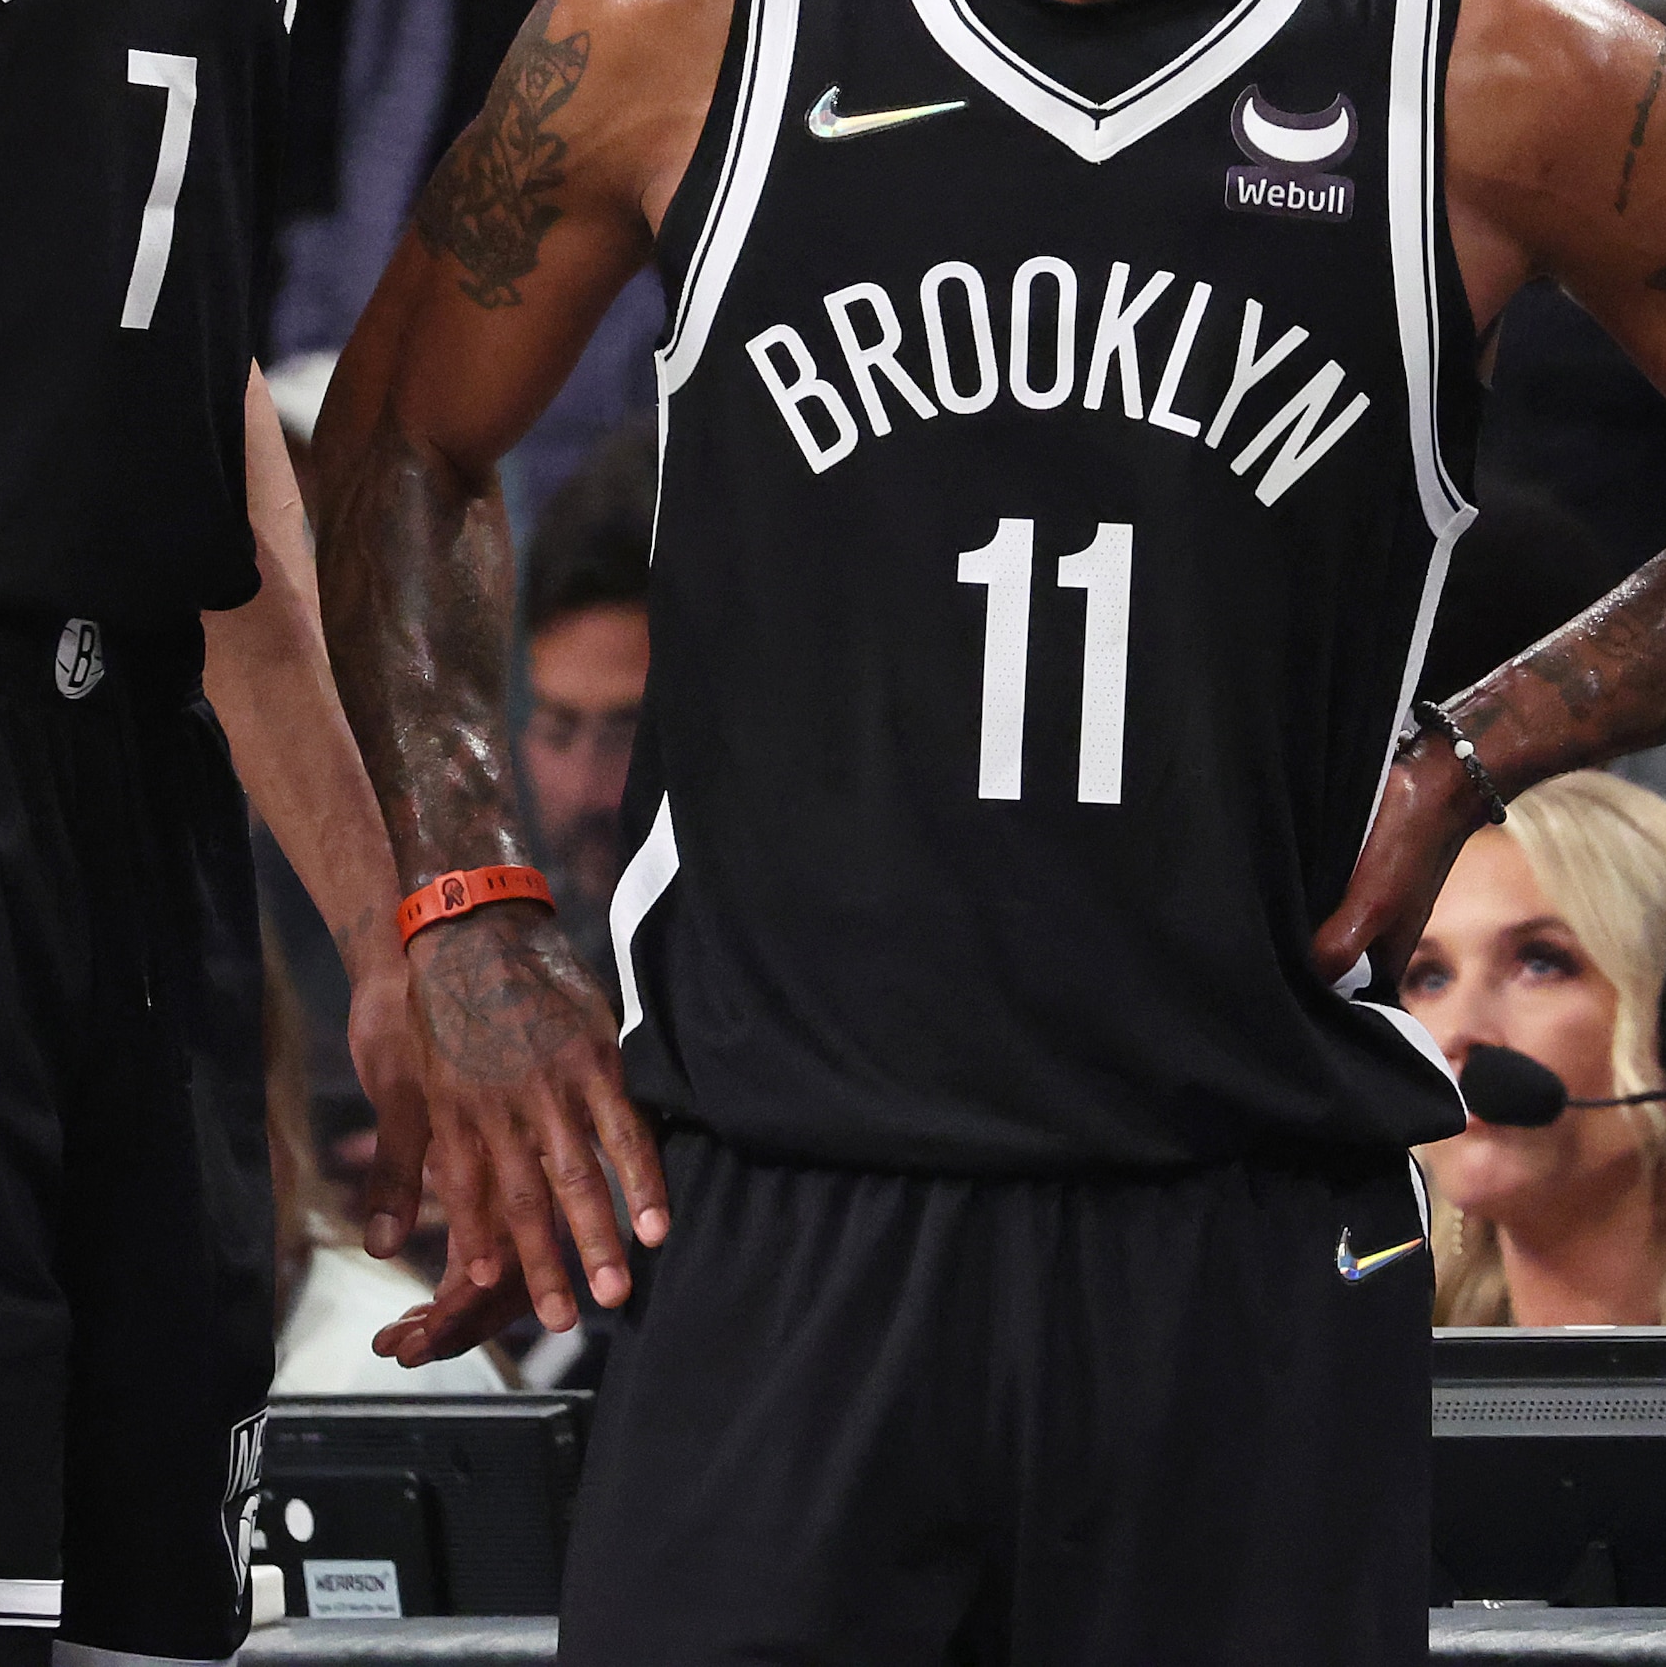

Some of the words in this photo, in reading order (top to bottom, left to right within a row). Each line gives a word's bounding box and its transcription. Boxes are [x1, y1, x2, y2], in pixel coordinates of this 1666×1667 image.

[120, 48, 198, 330] 7
[1237, 175, 1345, 215] Webull
[745, 255, 1371, 508] BROOKLYN
[957, 517, 1133, 804] 11
